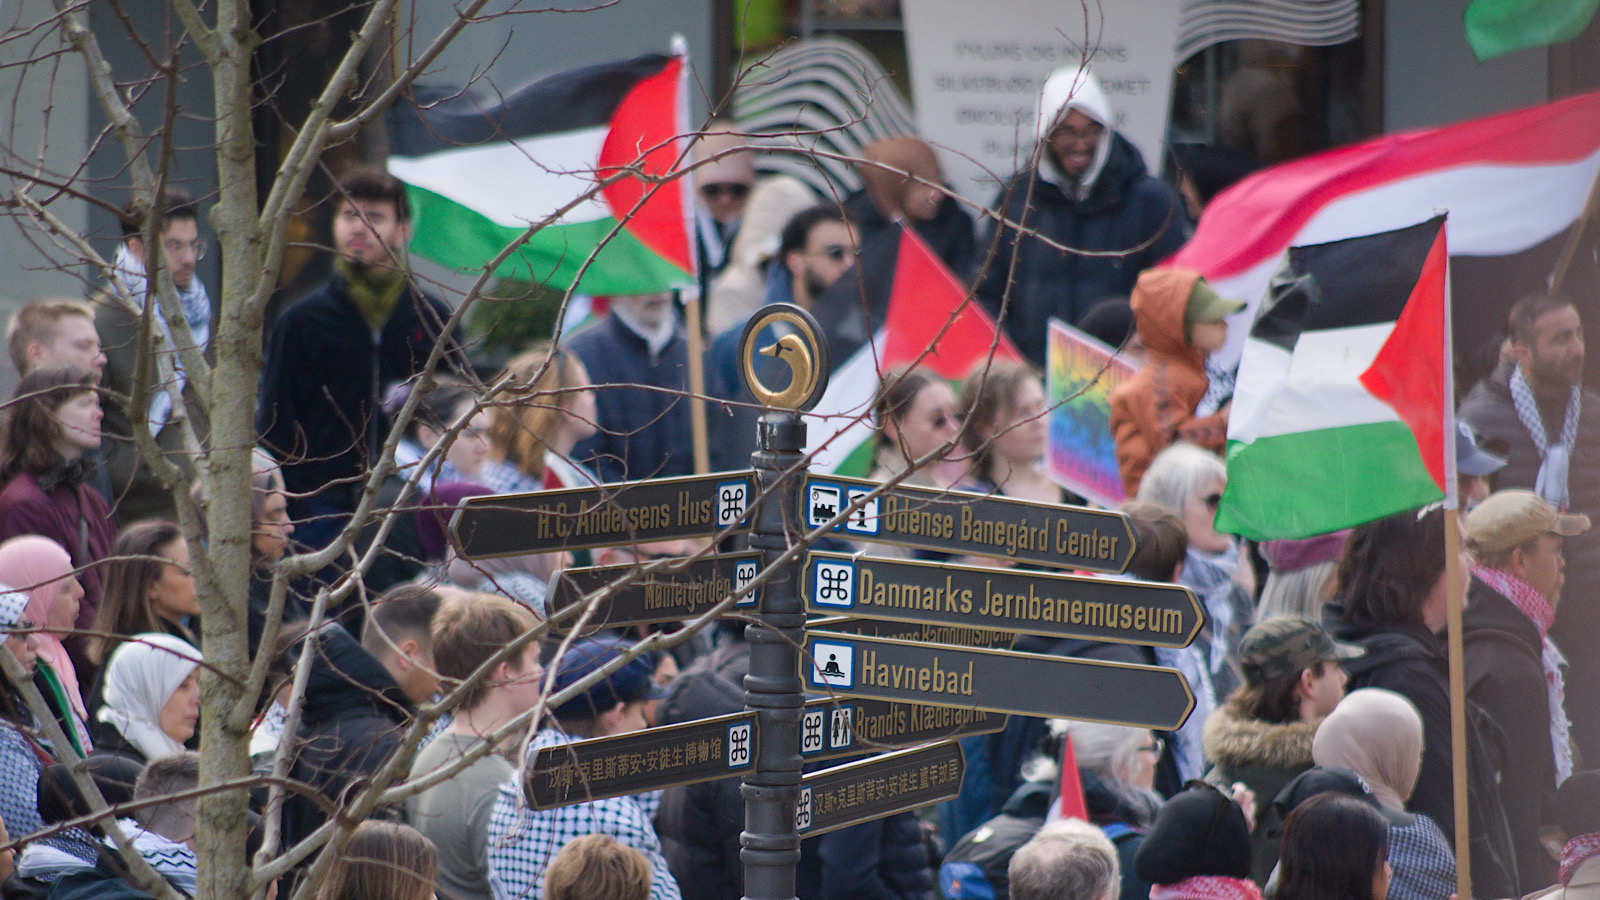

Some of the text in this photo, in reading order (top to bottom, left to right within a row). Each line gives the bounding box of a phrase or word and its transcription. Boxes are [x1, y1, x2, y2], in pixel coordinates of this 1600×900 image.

[576, 499, 671, 536] Andersens
[678, 490, 711, 527] Hus
[885, 496, 1119, 561] Odense Banegård Center
[644, 568, 731, 613] Møntergården
[859, 568, 1183, 635] Danmarks Jernbanemuseum
[861, 649, 974, 696] Havnebad
[855, 702, 906, 740] Brandts
